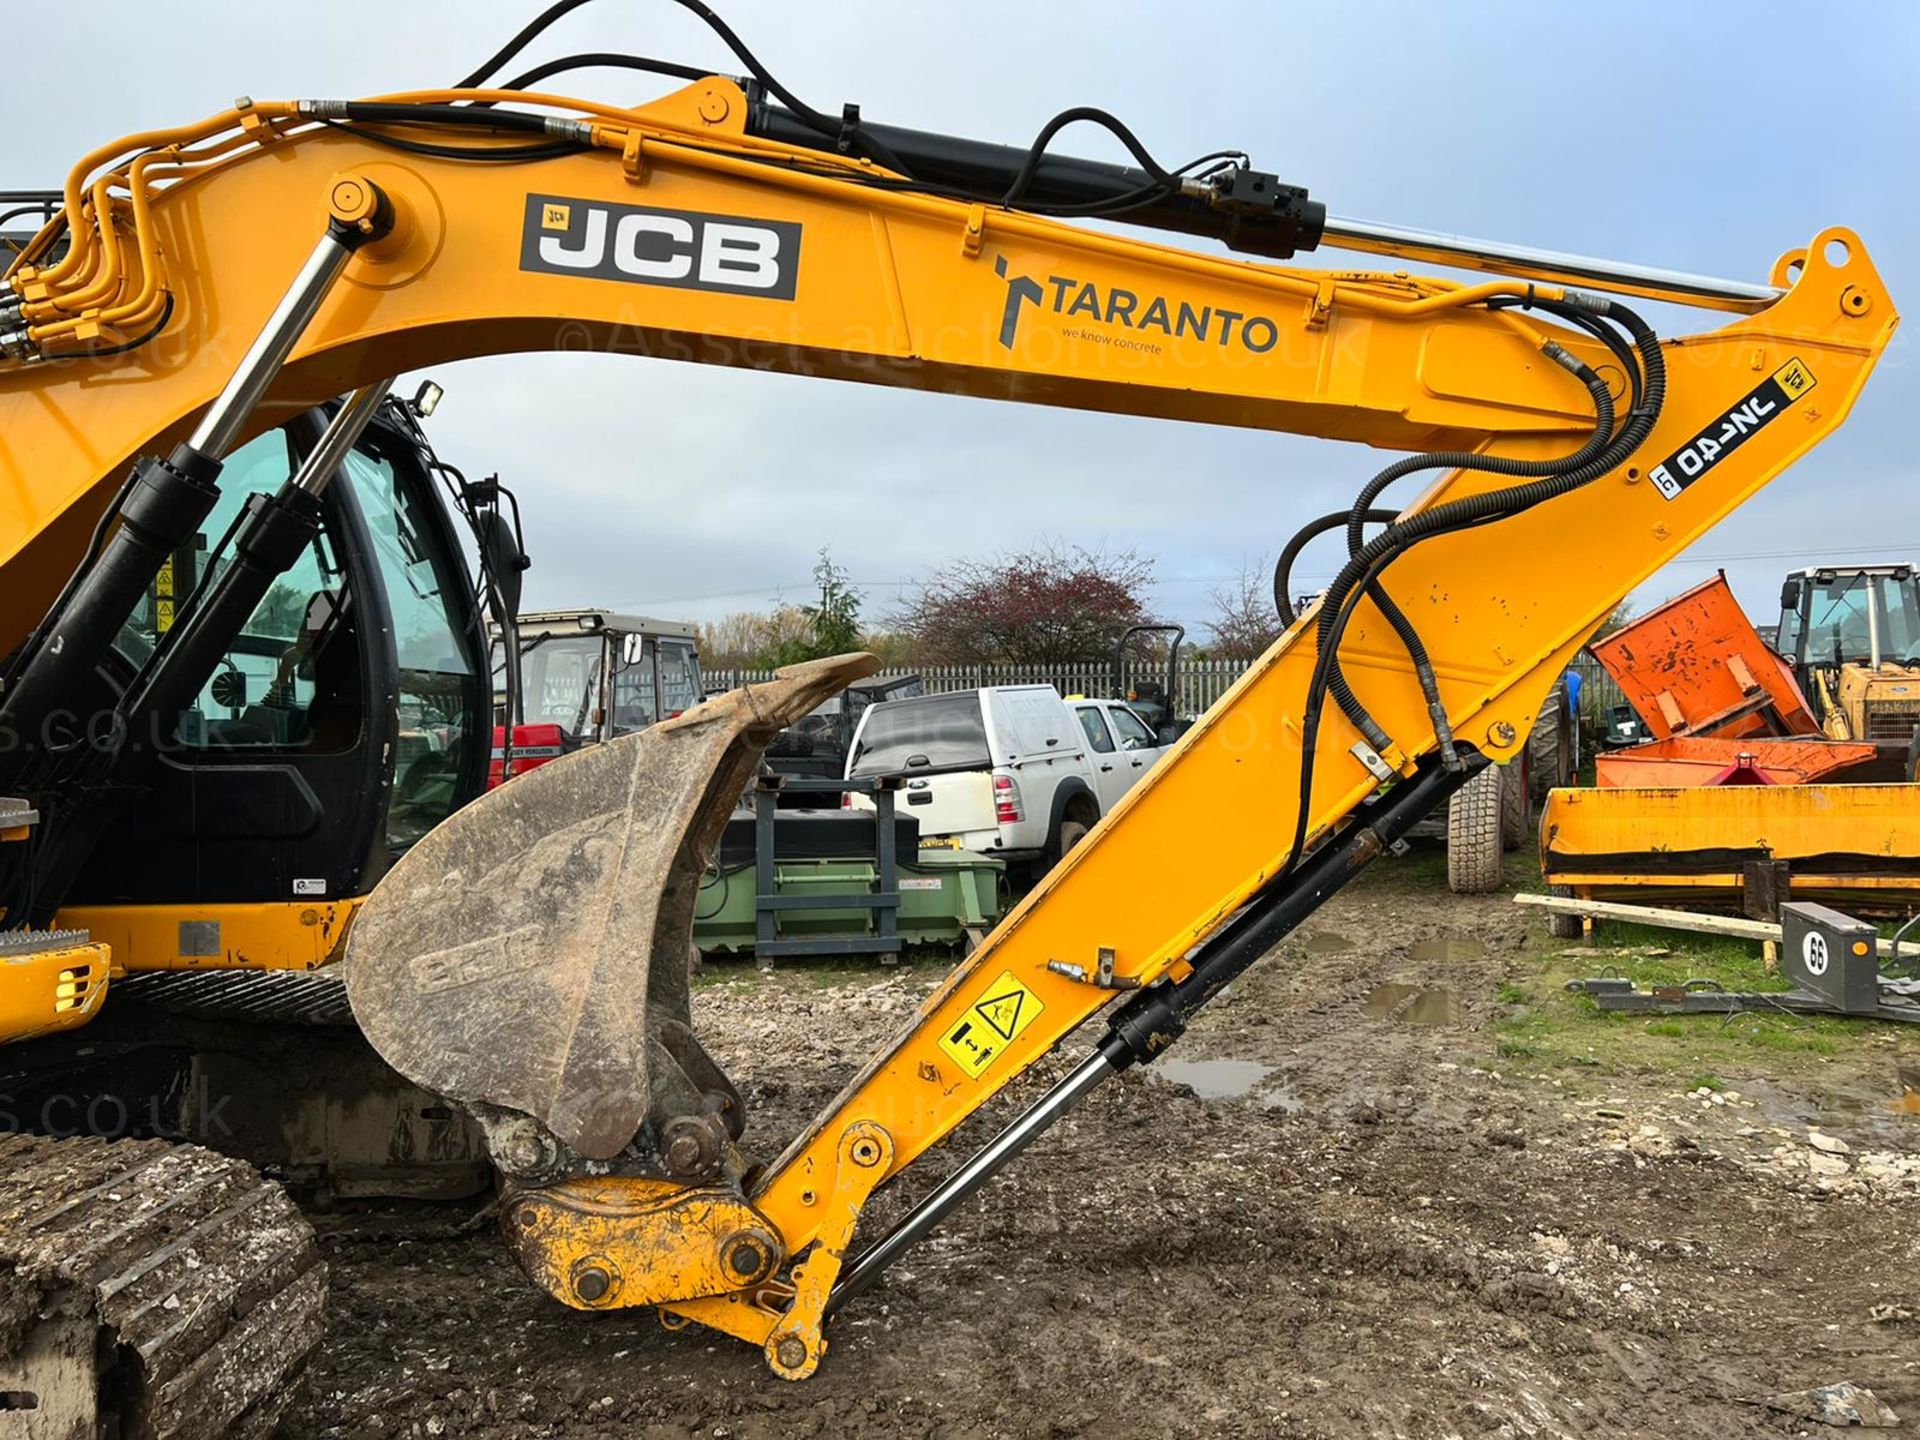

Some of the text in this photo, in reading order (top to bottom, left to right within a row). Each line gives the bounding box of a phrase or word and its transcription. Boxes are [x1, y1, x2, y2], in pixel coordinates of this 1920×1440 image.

[539, 208, 780, 289] JCB
[1048, 275, 1279, 354] TARANTO
[1062, 327, 1163, 356] we know concrete
[1784, 368, 1805, 390] JCB
[1656, 472, 1674, 491] LC
[1810, 936, 1824, 971] 66
